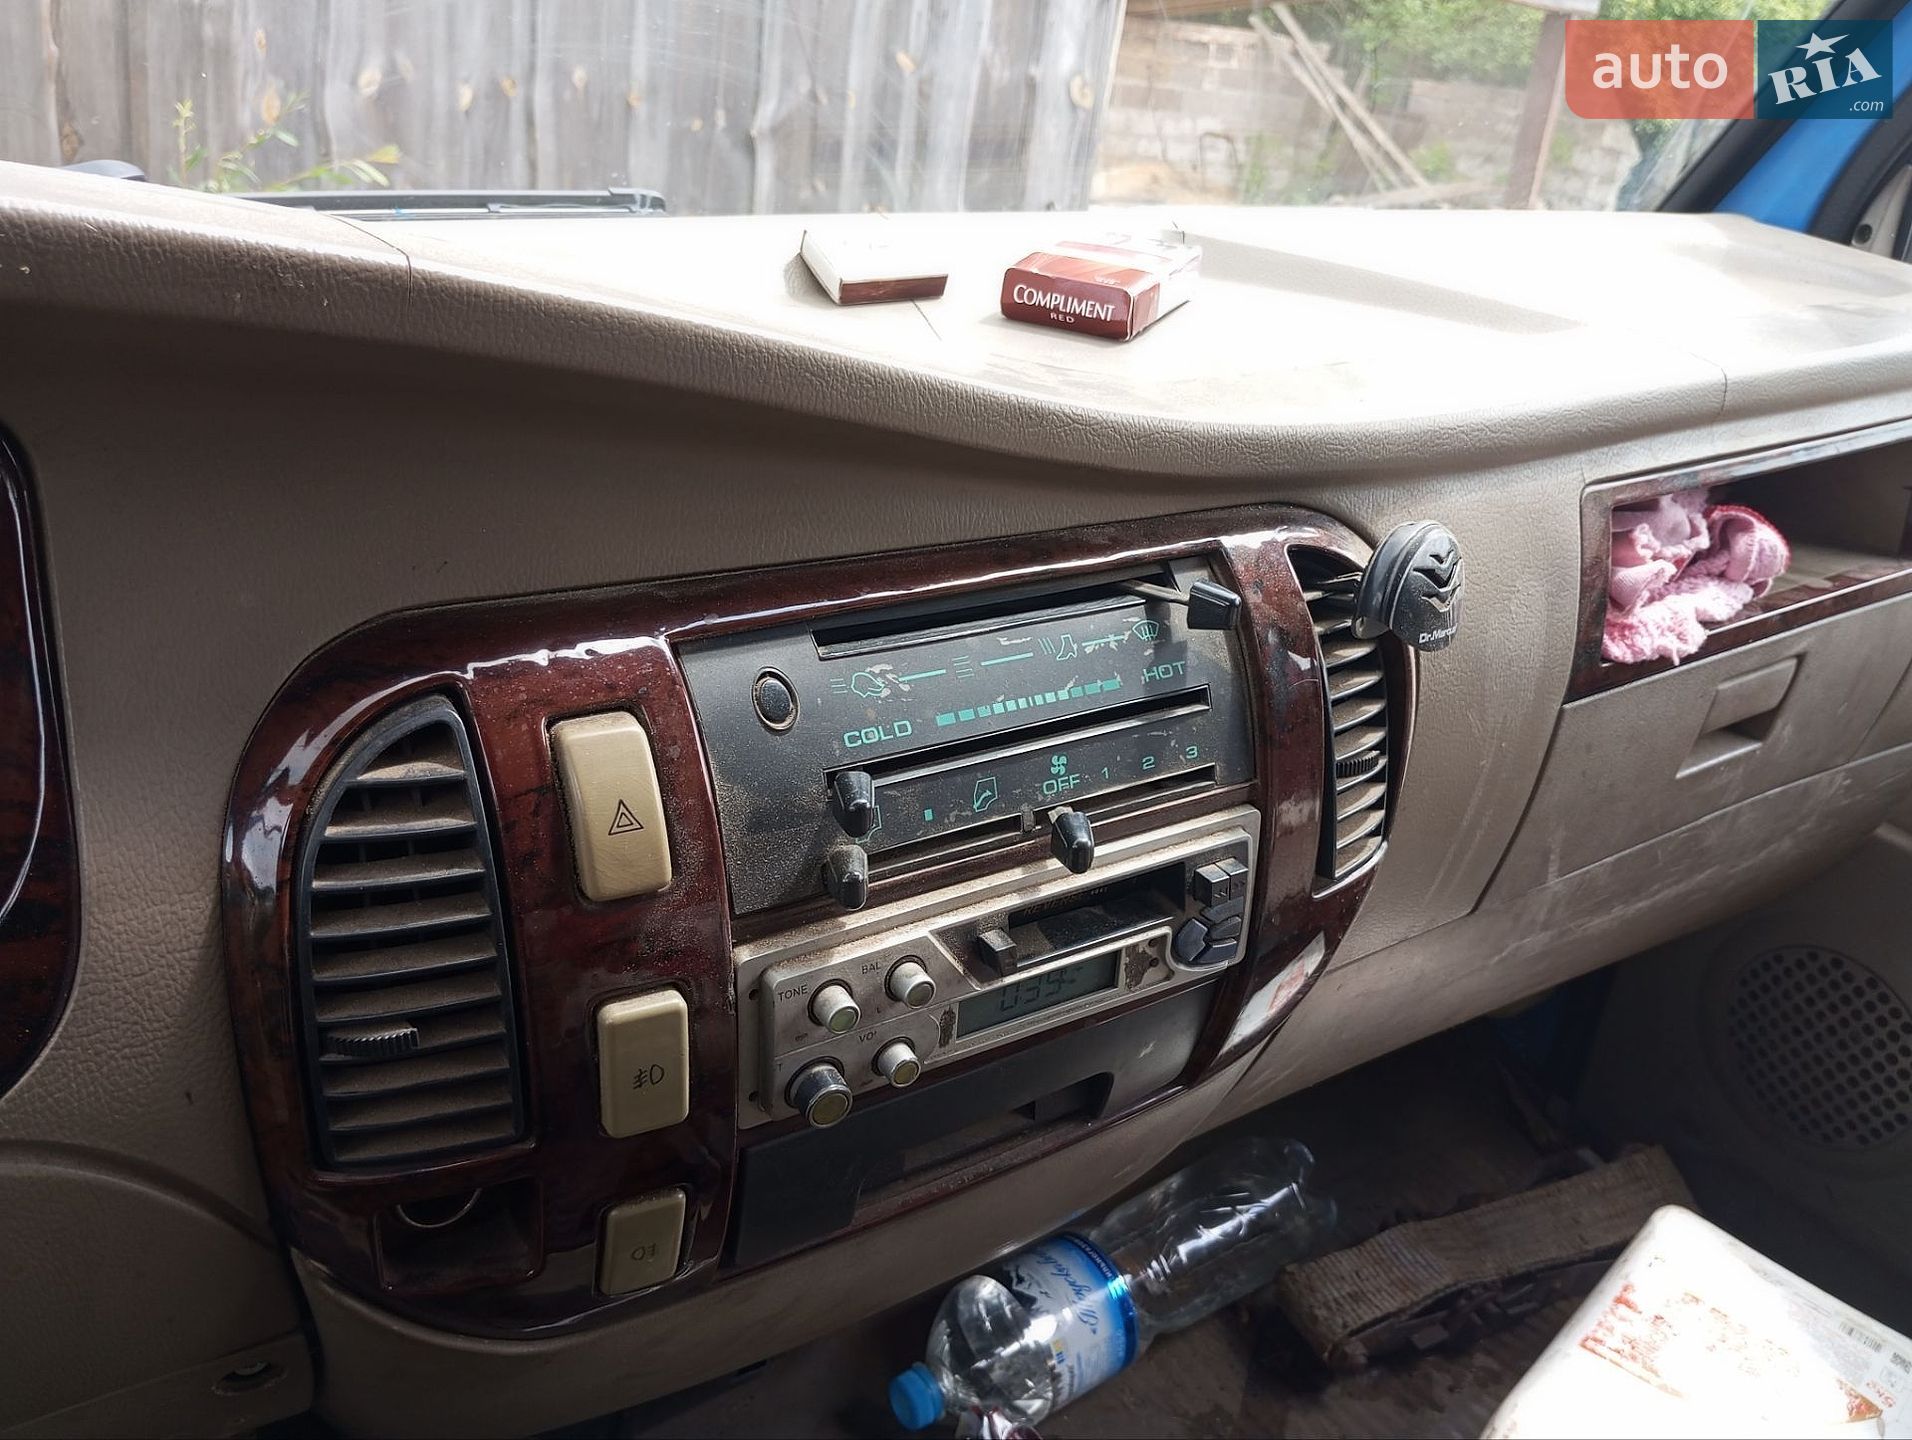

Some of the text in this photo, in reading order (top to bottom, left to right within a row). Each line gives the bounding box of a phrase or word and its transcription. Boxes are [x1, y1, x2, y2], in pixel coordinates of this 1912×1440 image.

[1012, 284, 1116, 322] COMPLIMENT
[1049, 312, 1076, 324] RED
[1143, 661, 1186, 683] HOT
[842, 719, 913, 749] COLD
[1042, 745, 1199, 796] OFF 1 2 3
[777, 983, 808, 1001] TONE
[859, 1031, 878, 1043] VO
